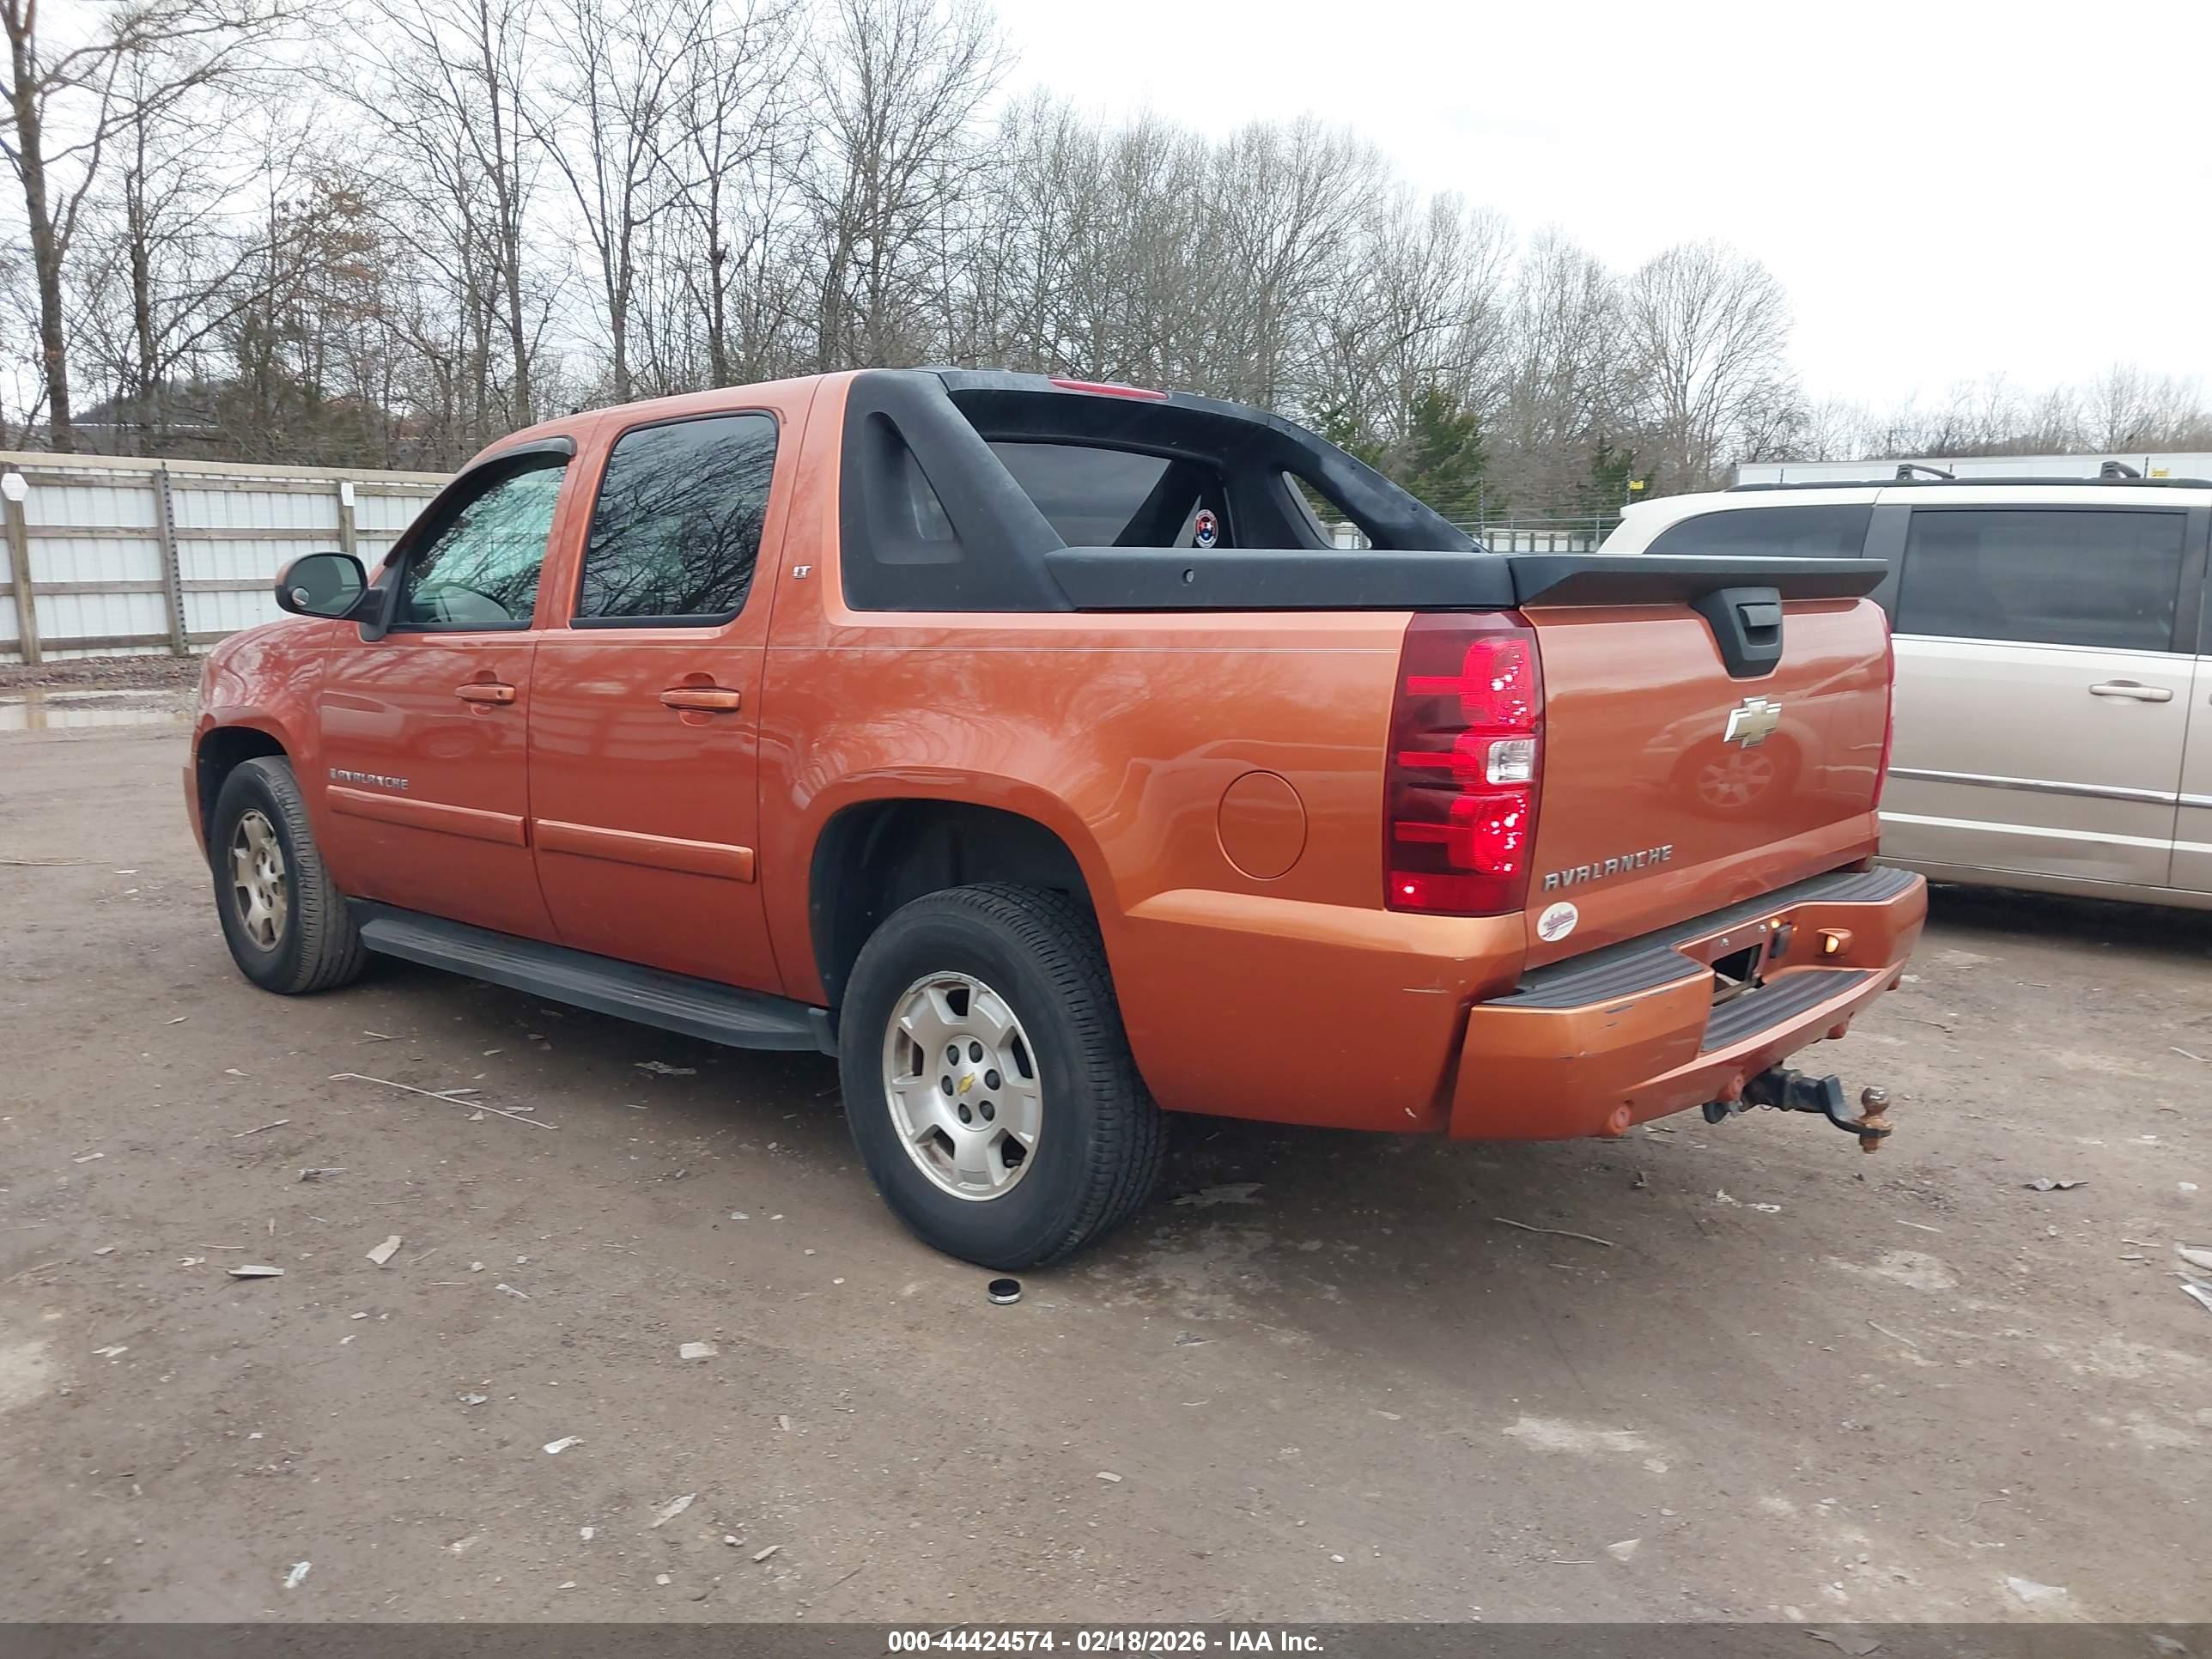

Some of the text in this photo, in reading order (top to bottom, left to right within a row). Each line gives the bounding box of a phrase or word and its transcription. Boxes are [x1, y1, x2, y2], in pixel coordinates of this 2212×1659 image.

[793, 565, 811, 579] LT
[337, 769, 409, 790] AVALANCHE
[1543, 844, 1674, 891] AVALANCHE
